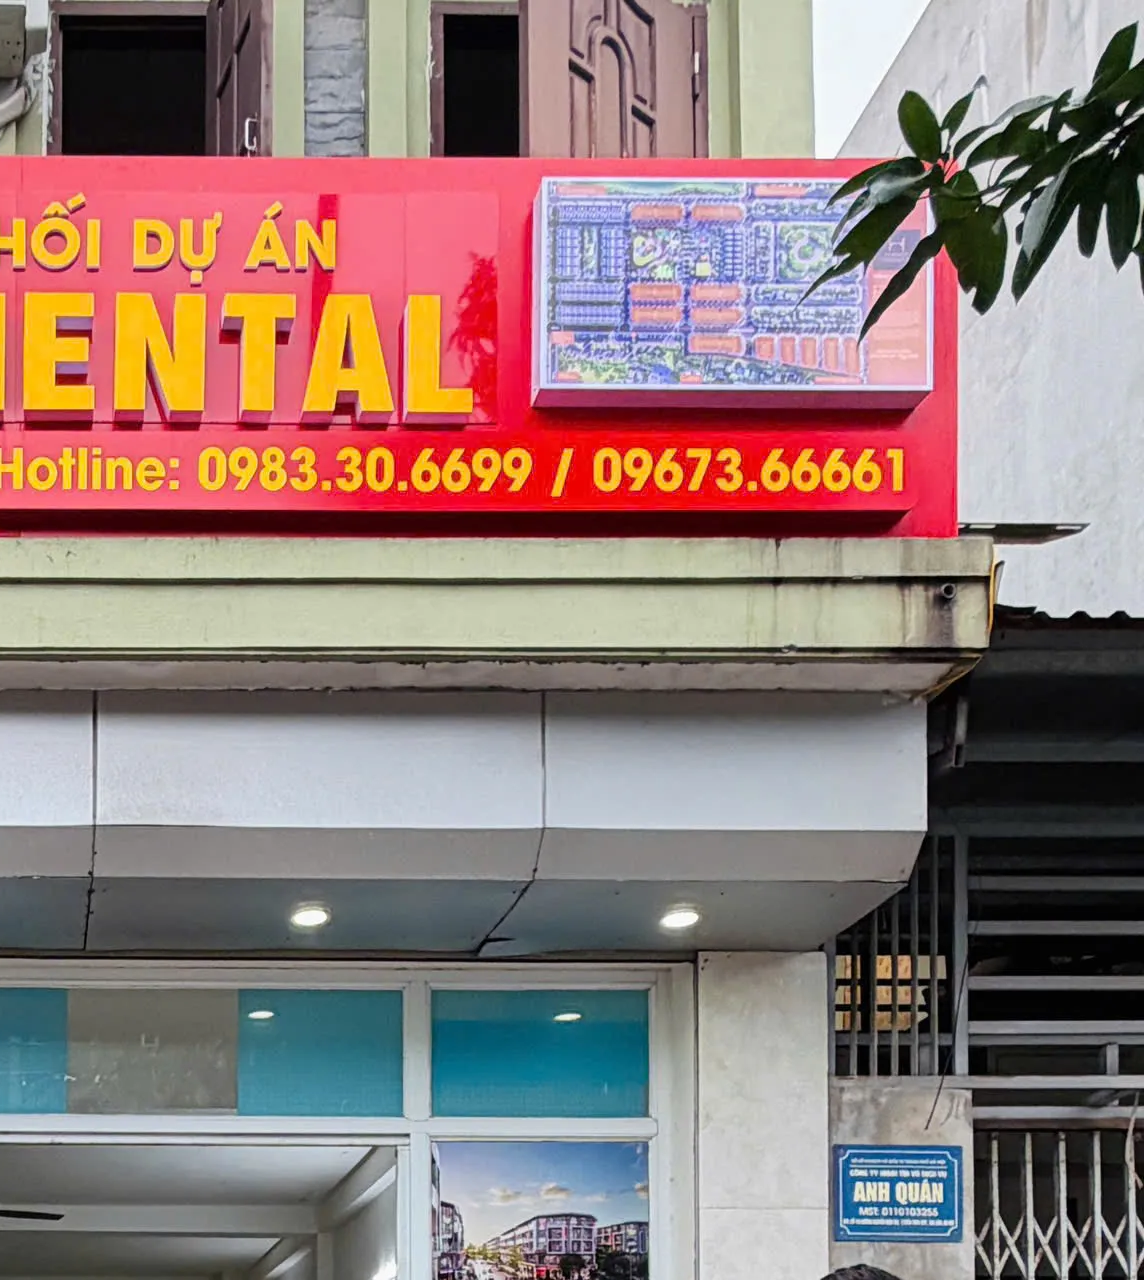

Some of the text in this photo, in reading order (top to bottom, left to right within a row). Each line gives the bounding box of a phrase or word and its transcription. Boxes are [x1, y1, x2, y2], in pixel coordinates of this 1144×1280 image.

[133, 211, 222, 285] DỰ
[244, 201, 337, 271] ÁN
[197, 445, 533, 493] 0983.30.6699
[592, 446, 905, 494] 09673.66661
[853, 1181, 890, 1203] ANH
